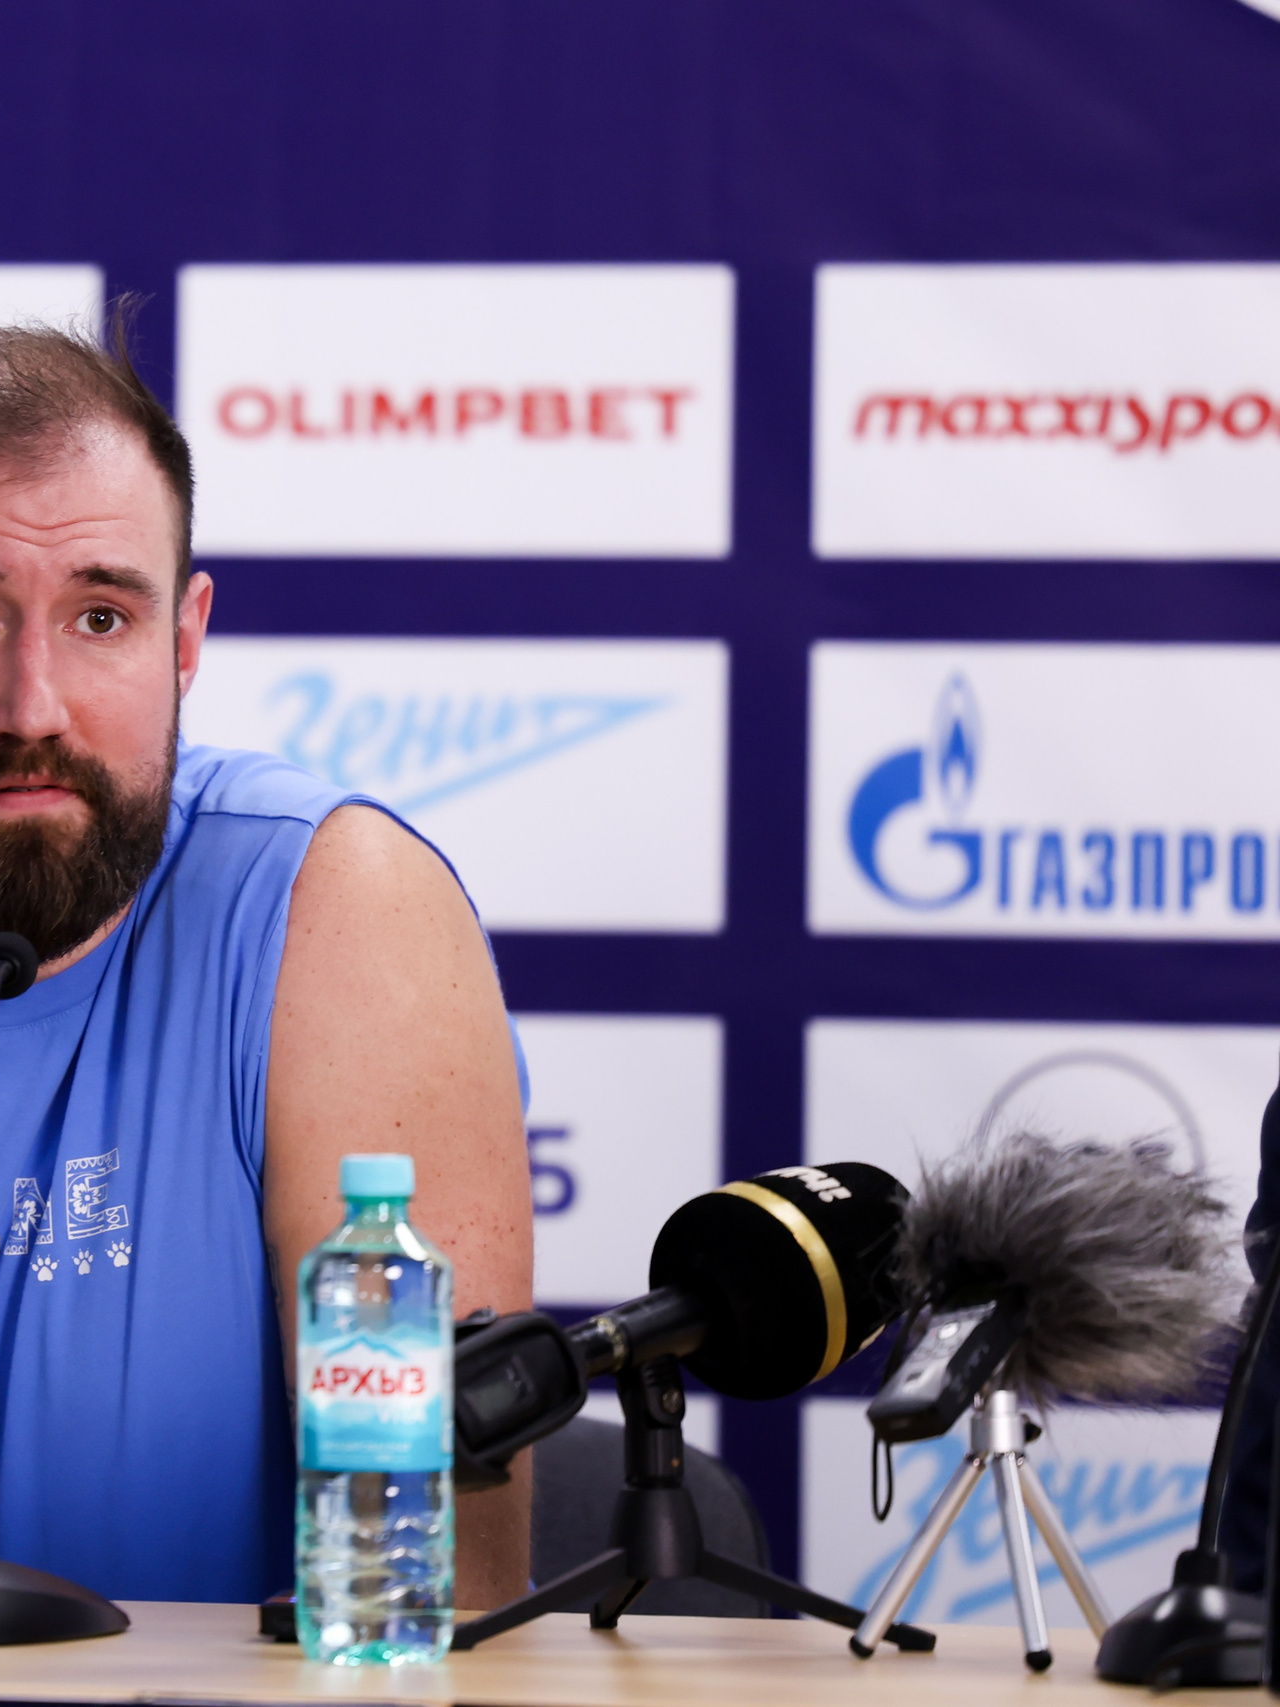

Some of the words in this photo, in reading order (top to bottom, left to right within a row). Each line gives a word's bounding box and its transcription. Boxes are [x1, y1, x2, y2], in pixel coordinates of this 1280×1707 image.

[215, 385, 694, 440] OLIMPBET
[850, 392, 1280, 456] maxxispo
[996, 828, 1280, 912] ГАЗПРО
[310, 1365, 425, 1396] АРХЫЗ
